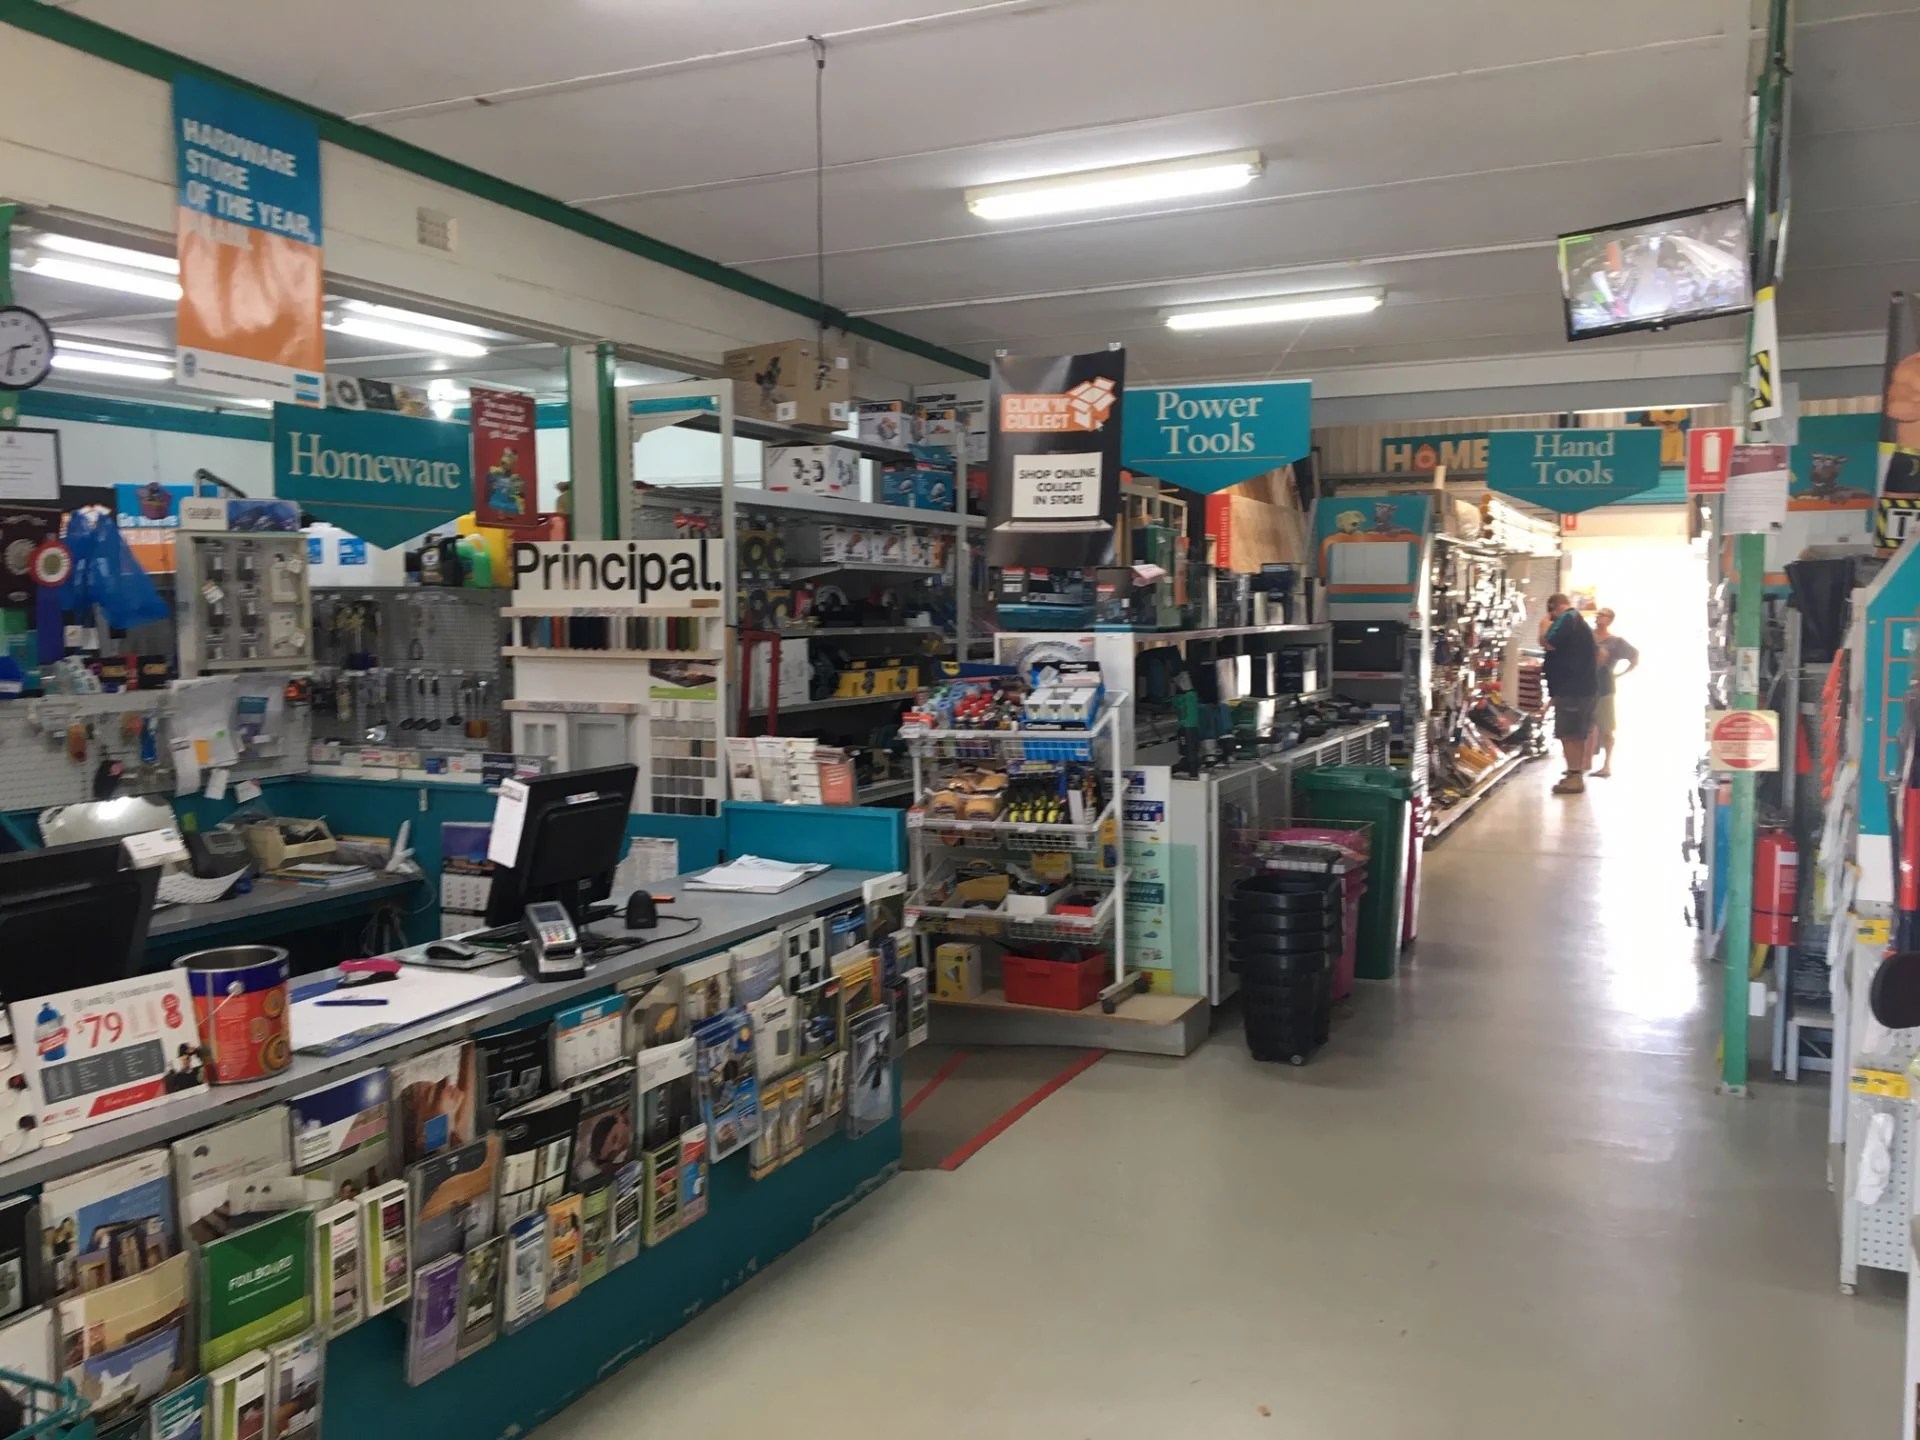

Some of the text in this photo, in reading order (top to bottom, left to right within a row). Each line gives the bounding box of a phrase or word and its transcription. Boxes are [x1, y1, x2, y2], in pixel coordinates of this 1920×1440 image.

[183, 118, 298, 177] HARDWARE
[186, 149, 249, 191] STORE
[186, 180, 212, 208] OF
[216, 189, 255, 221] THE
[1155, 391, 1264, 420] Power
[1006, 413, 1071, 429] COLLECT
[1160, 422, 1255, 455] Tools
[1533, 432, 1615, 458] Hand
[288, 431, 461, 489] Homeware
[1019, 467, 1096, 480] SHOP ONLINE
[1532, 460, 1614, 485] Tools
[1033, 494, 1084, 505] IN STORE
[1036, 481, 1083, 493] COLLECT
[513, 539, 722, 604] Principal.
